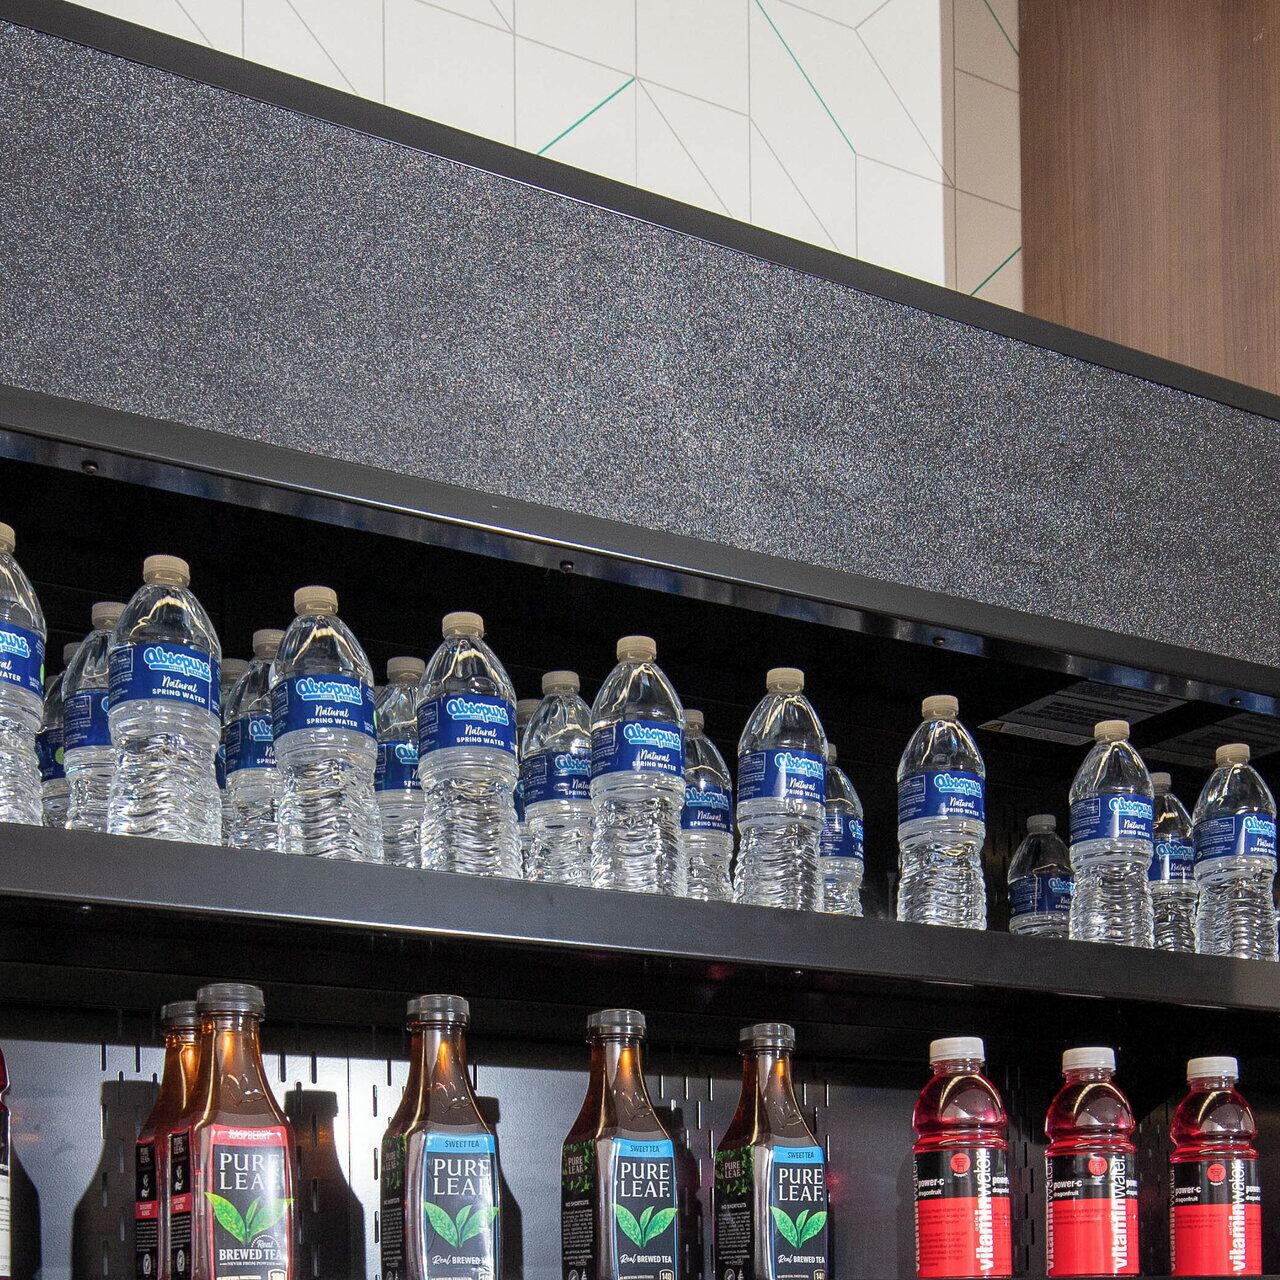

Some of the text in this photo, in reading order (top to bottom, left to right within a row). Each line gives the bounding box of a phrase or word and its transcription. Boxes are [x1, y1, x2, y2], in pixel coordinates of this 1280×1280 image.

[143, 647, 212, 679] Absopure
[445, 1140, 480, 1148] SWEET TEA
[630, 1145, 660, 1153] SWEET TEA
[433, 1158, 491, 1176] PURE
[620, 1162, 670, 1180] PURE
[620, 1254, 672, 1264] Real BREWED TEA
